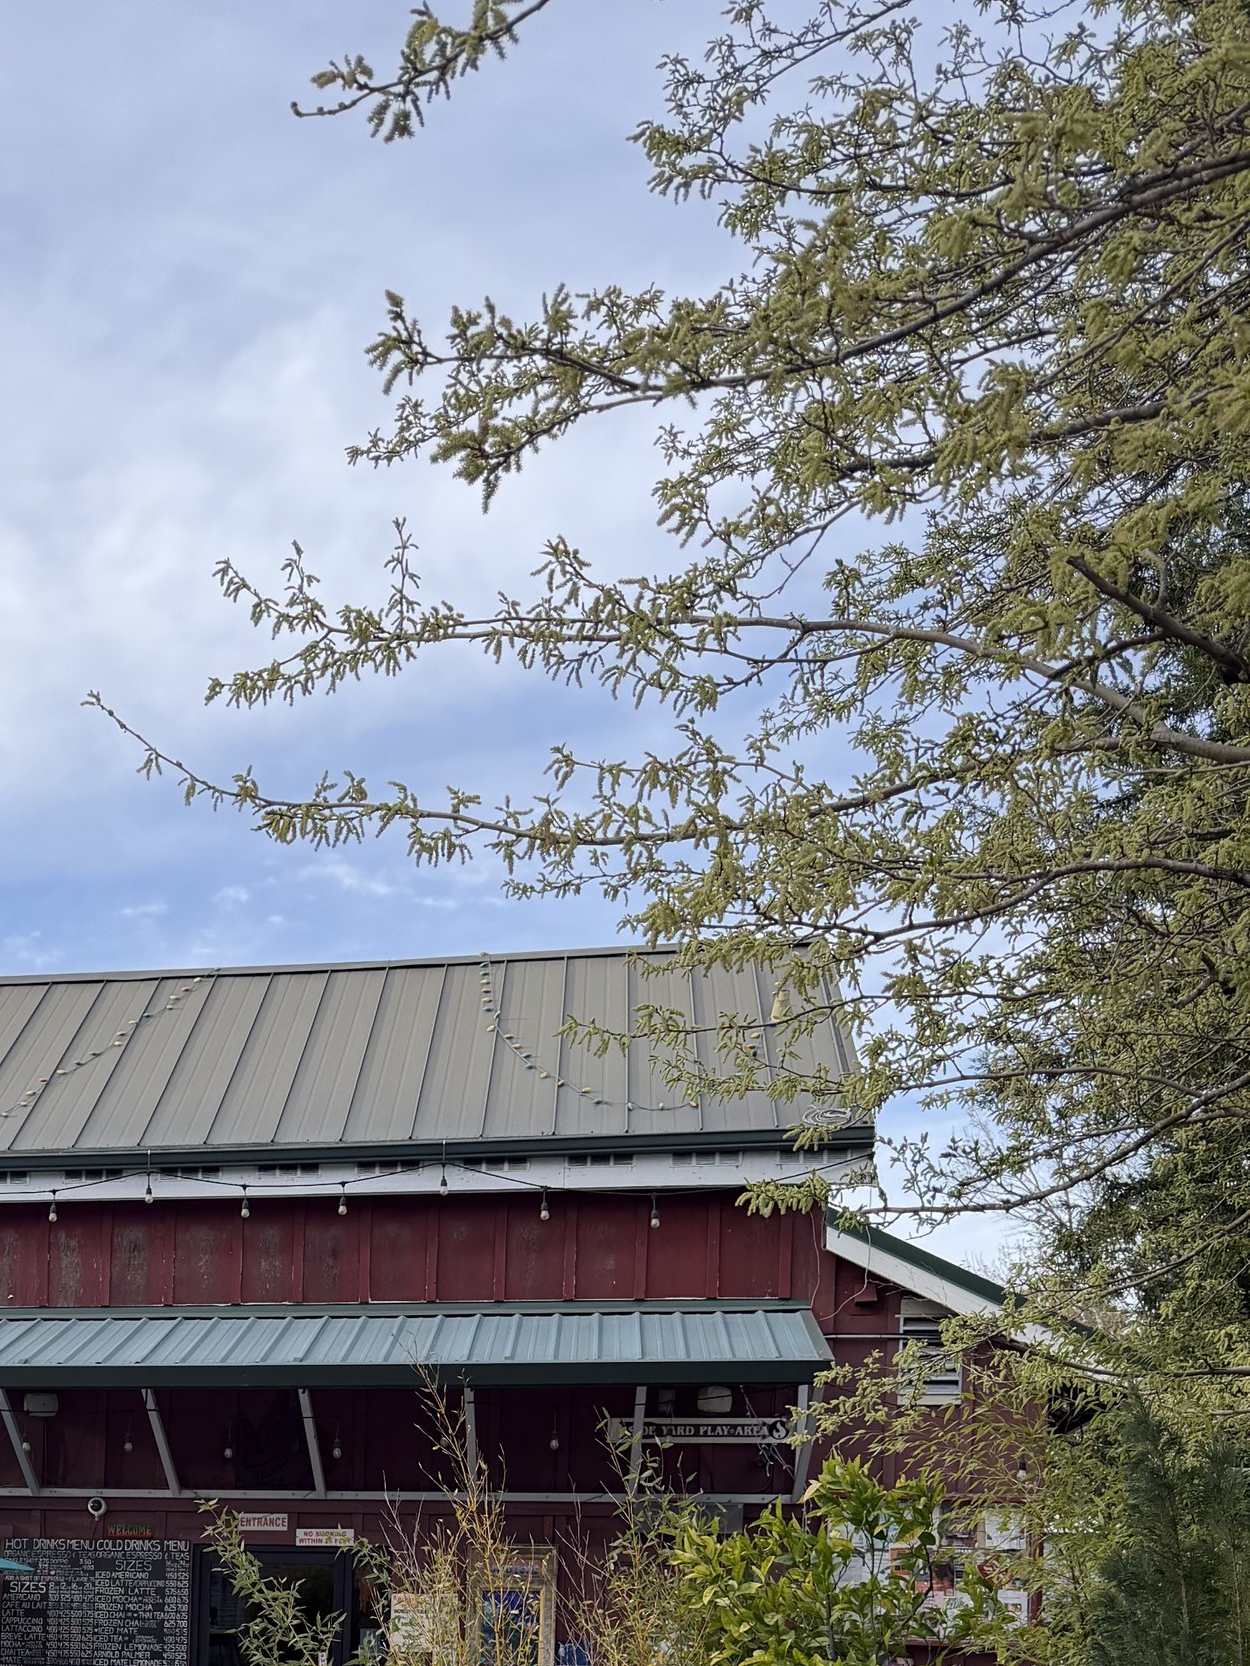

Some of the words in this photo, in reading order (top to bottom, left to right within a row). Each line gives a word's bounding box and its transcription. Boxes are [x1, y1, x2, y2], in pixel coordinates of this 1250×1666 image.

[629, 1426, 656, 1436] SDE
[662, 1426, 694, 1436] YARD
[700, 1426, 731, 1436] PLAY
[734, 1426, 770, 1436] AREA
[240, 1517, 286, 1527] ENTRANCE
[108, 1524, 152, 1536] WELCOME
[6, 1539, 30, 1549] HOT
[33, 1539, 66, 1550] DRINKS
[66, 1540, 94, 1550] MENU
[97, 1540, 123, 1551] COLD
[124, 1540, 161, 1551] DRINKS
[164, 1541, 190, 1552] MENU
[126, 1552, 162, 1560] ESPRESSO
[116, 1560, 152, 1571] SIZES
[10, 1581, 46, 1593] SIZES
[154, 1612, 164, 1620] TEA
[1, 1632, 23, 1640] BREVE
